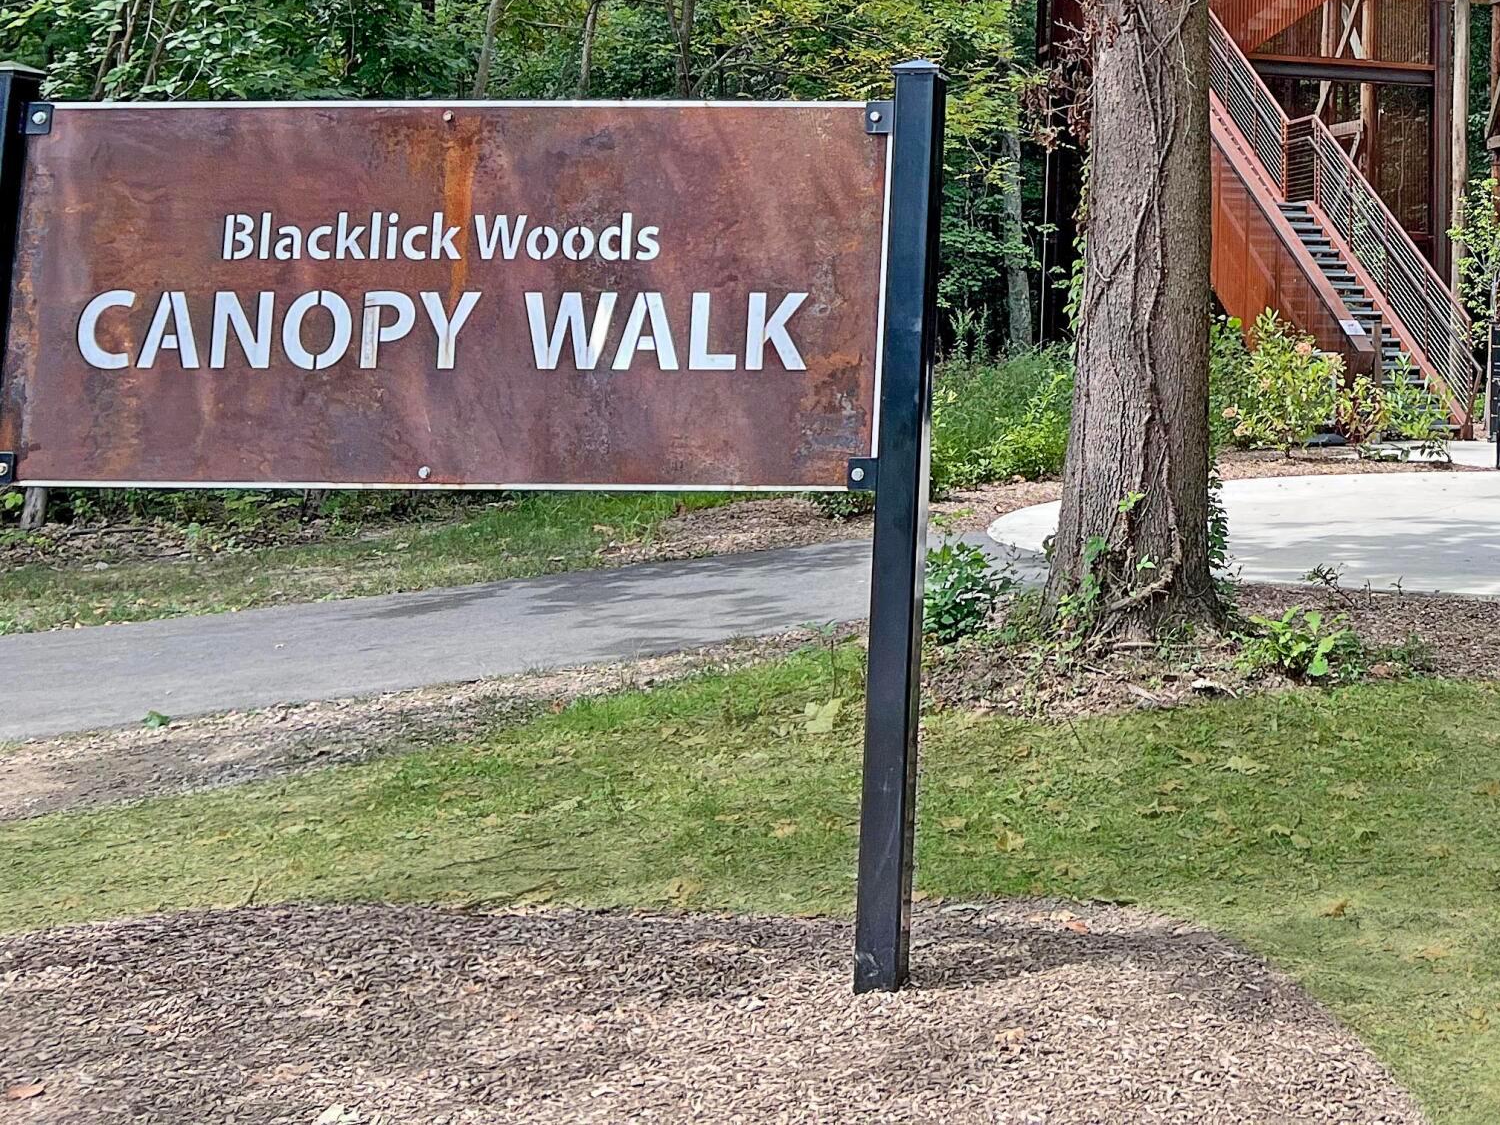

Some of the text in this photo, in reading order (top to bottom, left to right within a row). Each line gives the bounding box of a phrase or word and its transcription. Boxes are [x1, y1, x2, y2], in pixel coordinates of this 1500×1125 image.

[222, 212, 661, 262] Blacklick Woods
[77, 289, 808, 371] CANOPY WALK
